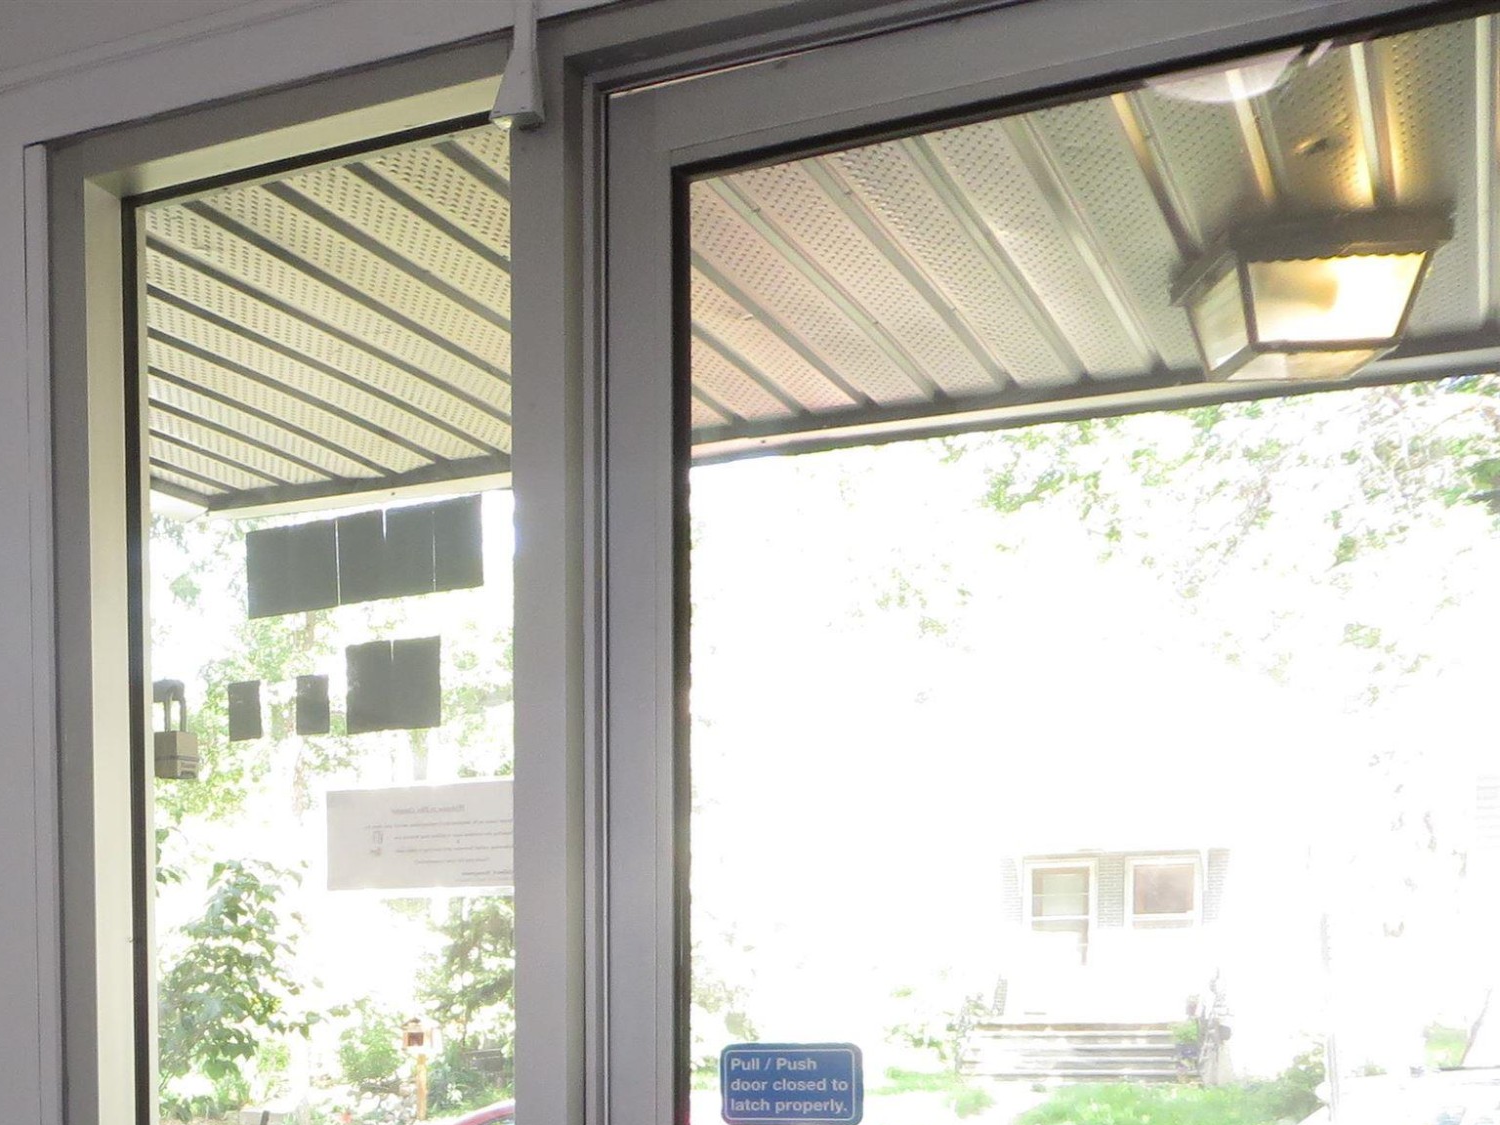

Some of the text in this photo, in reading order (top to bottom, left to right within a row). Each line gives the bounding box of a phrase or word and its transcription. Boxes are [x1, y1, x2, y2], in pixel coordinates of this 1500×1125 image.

[730, 1058, 760, 1071] Pull
[776, 1057, 817, 1071] Push
[730, 1078, 848, 1092] door closed to
[731, 1099, 847, 1114] latch properly.
